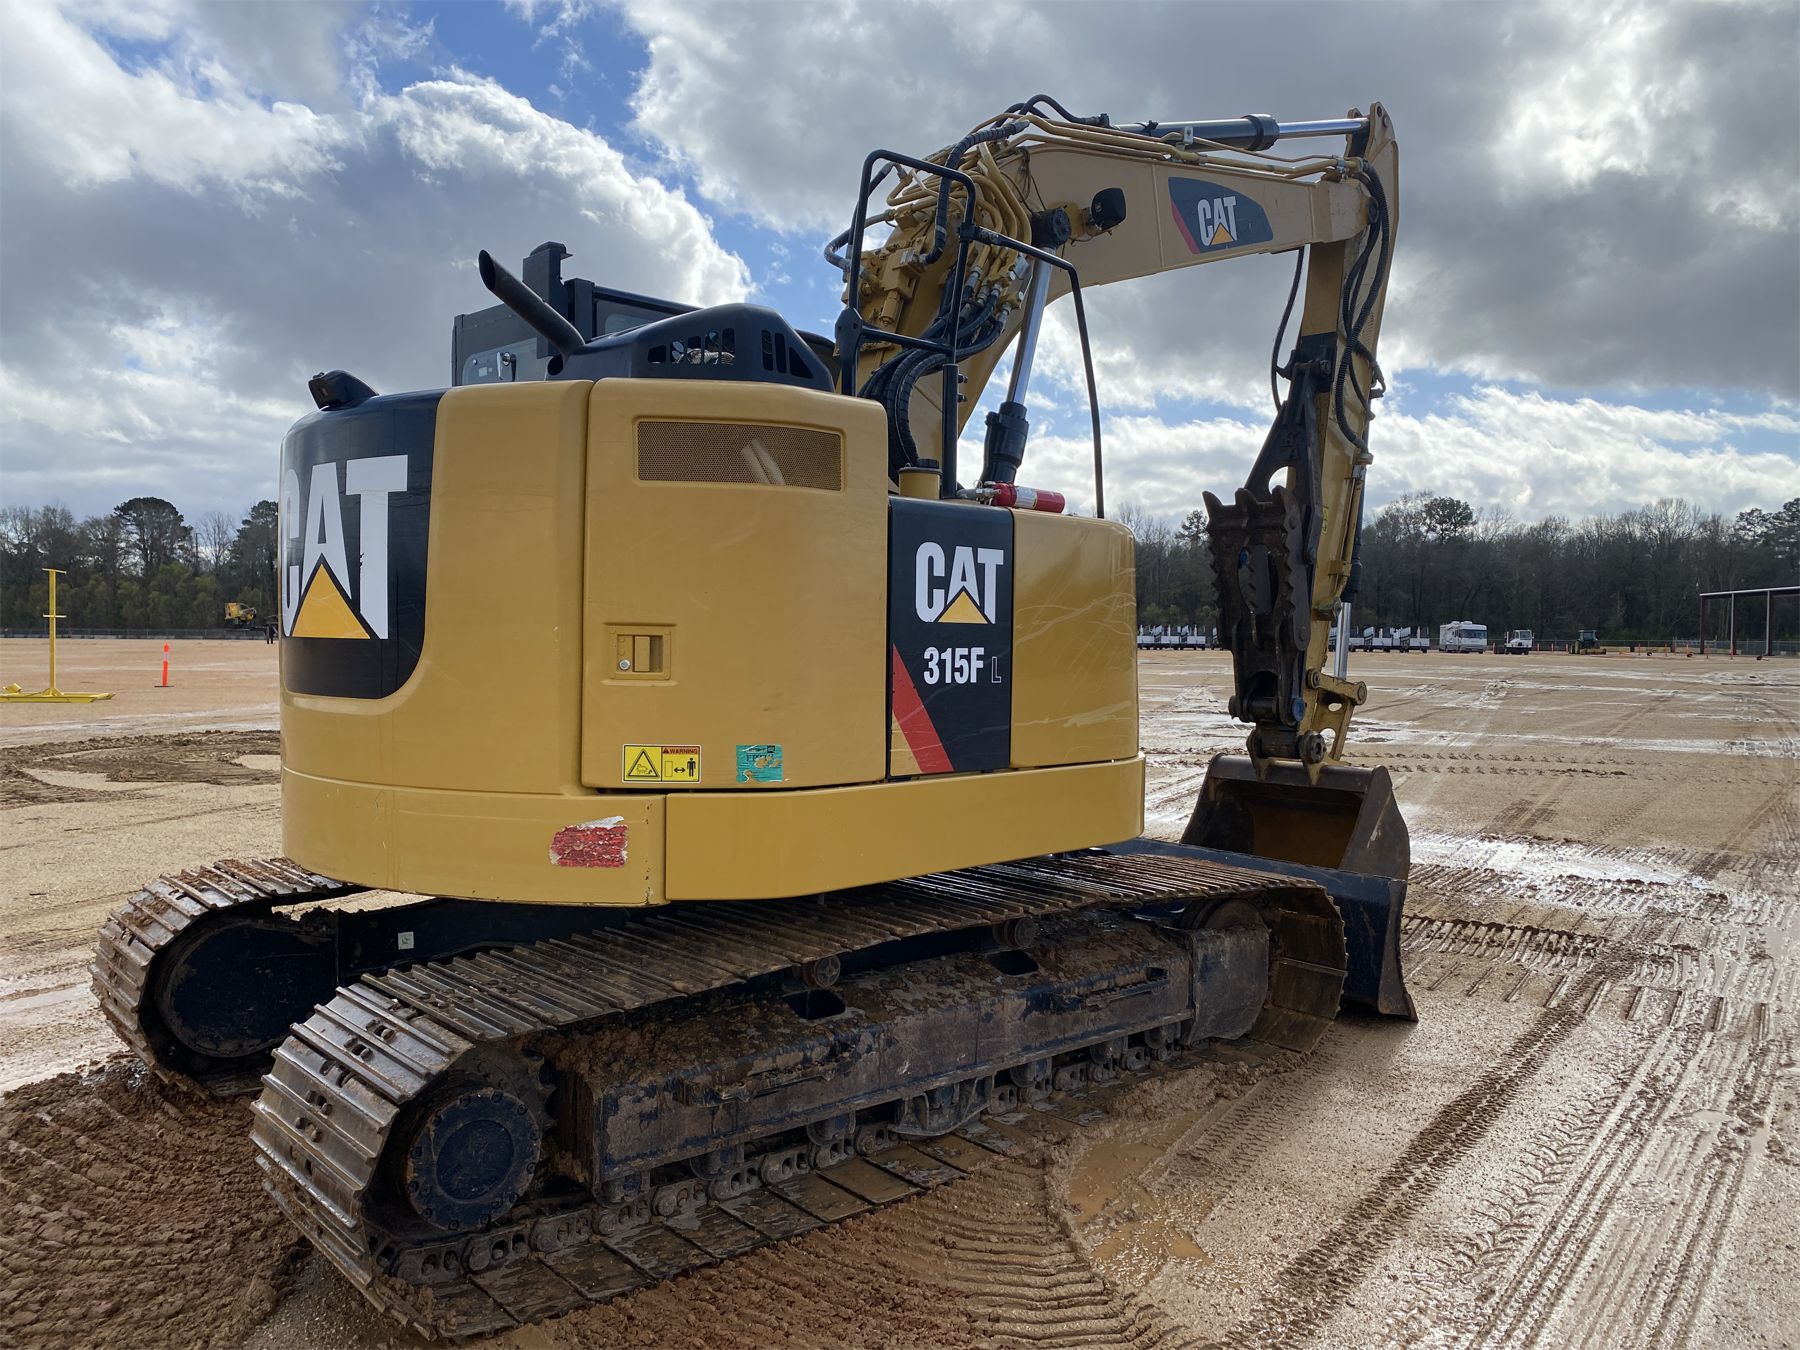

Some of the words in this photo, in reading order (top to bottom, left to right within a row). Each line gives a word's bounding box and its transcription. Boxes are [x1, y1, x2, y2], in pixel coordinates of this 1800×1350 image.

[1197, 195, 1238, 247] CAT
[281, 454, 408, 640] CAT
[915, 541, 1004, 625] CAT
[923, 646, 985, 685] 315F
[991, 656, 1002, 684] L
